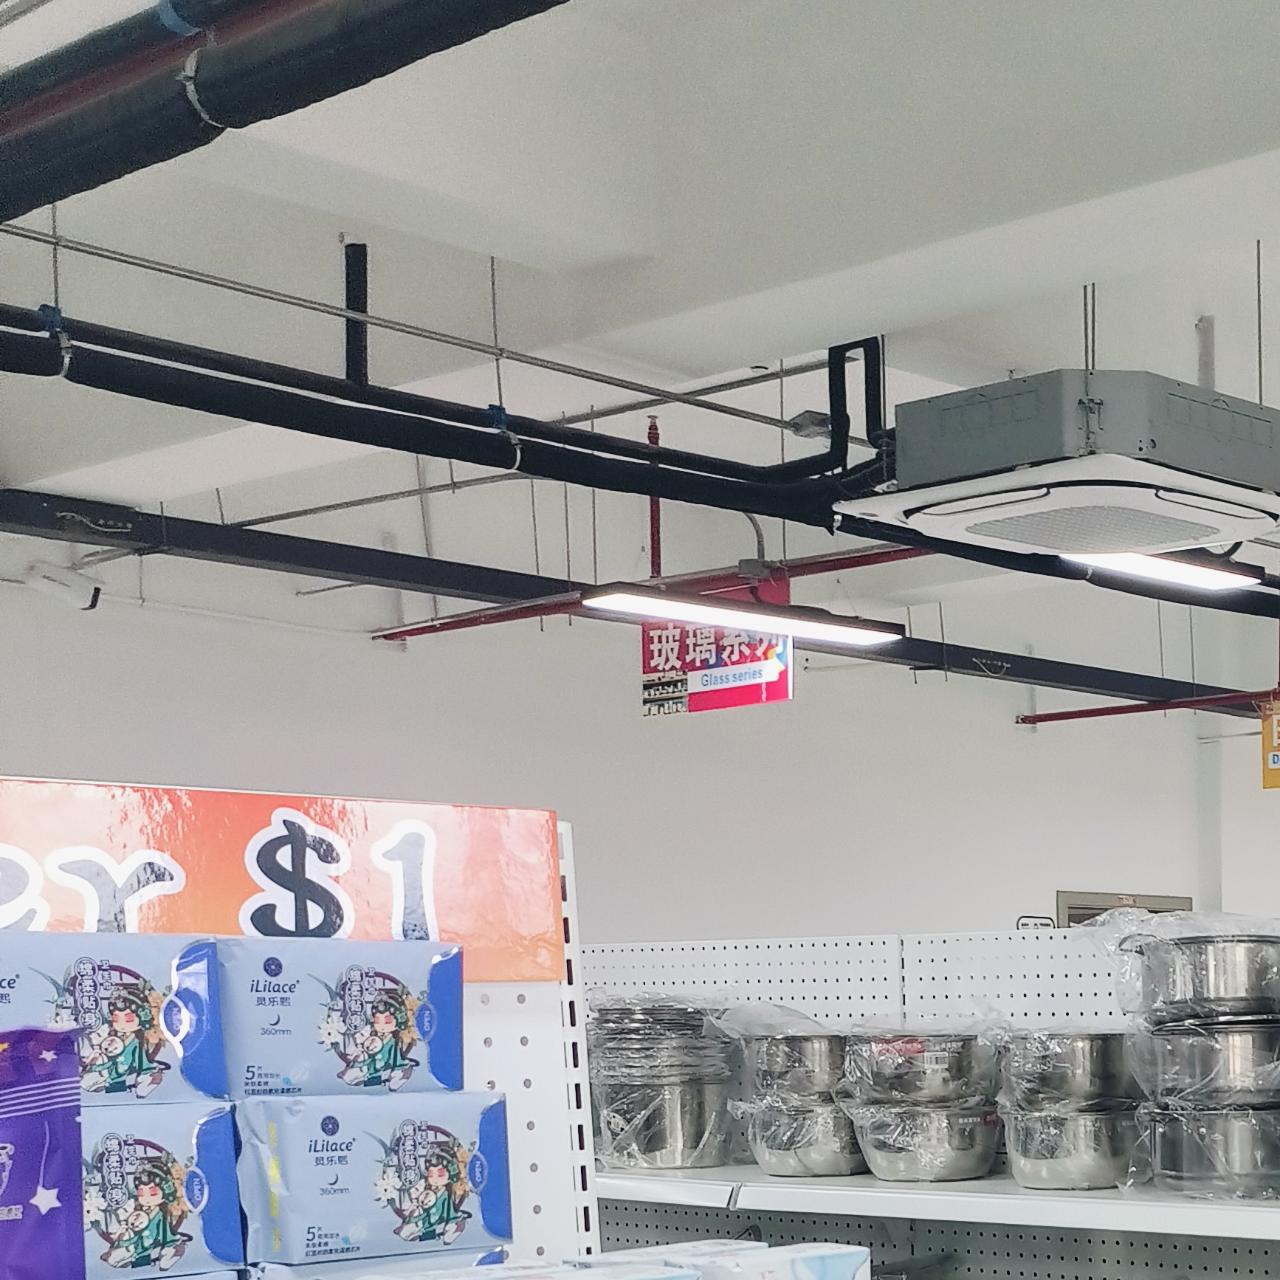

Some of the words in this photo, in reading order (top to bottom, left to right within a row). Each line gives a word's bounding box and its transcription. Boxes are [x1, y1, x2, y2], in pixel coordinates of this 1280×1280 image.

[701, 671, 730, 687] Glass
[732, 668, 763, 682] series
[422, 1010, 432, 1032] OPEN
[260, 1027, 292, 1036] 360mm
[192, 1177, 201, 1201] OPEN
[319, 1186, 350, 1196] 360mm
